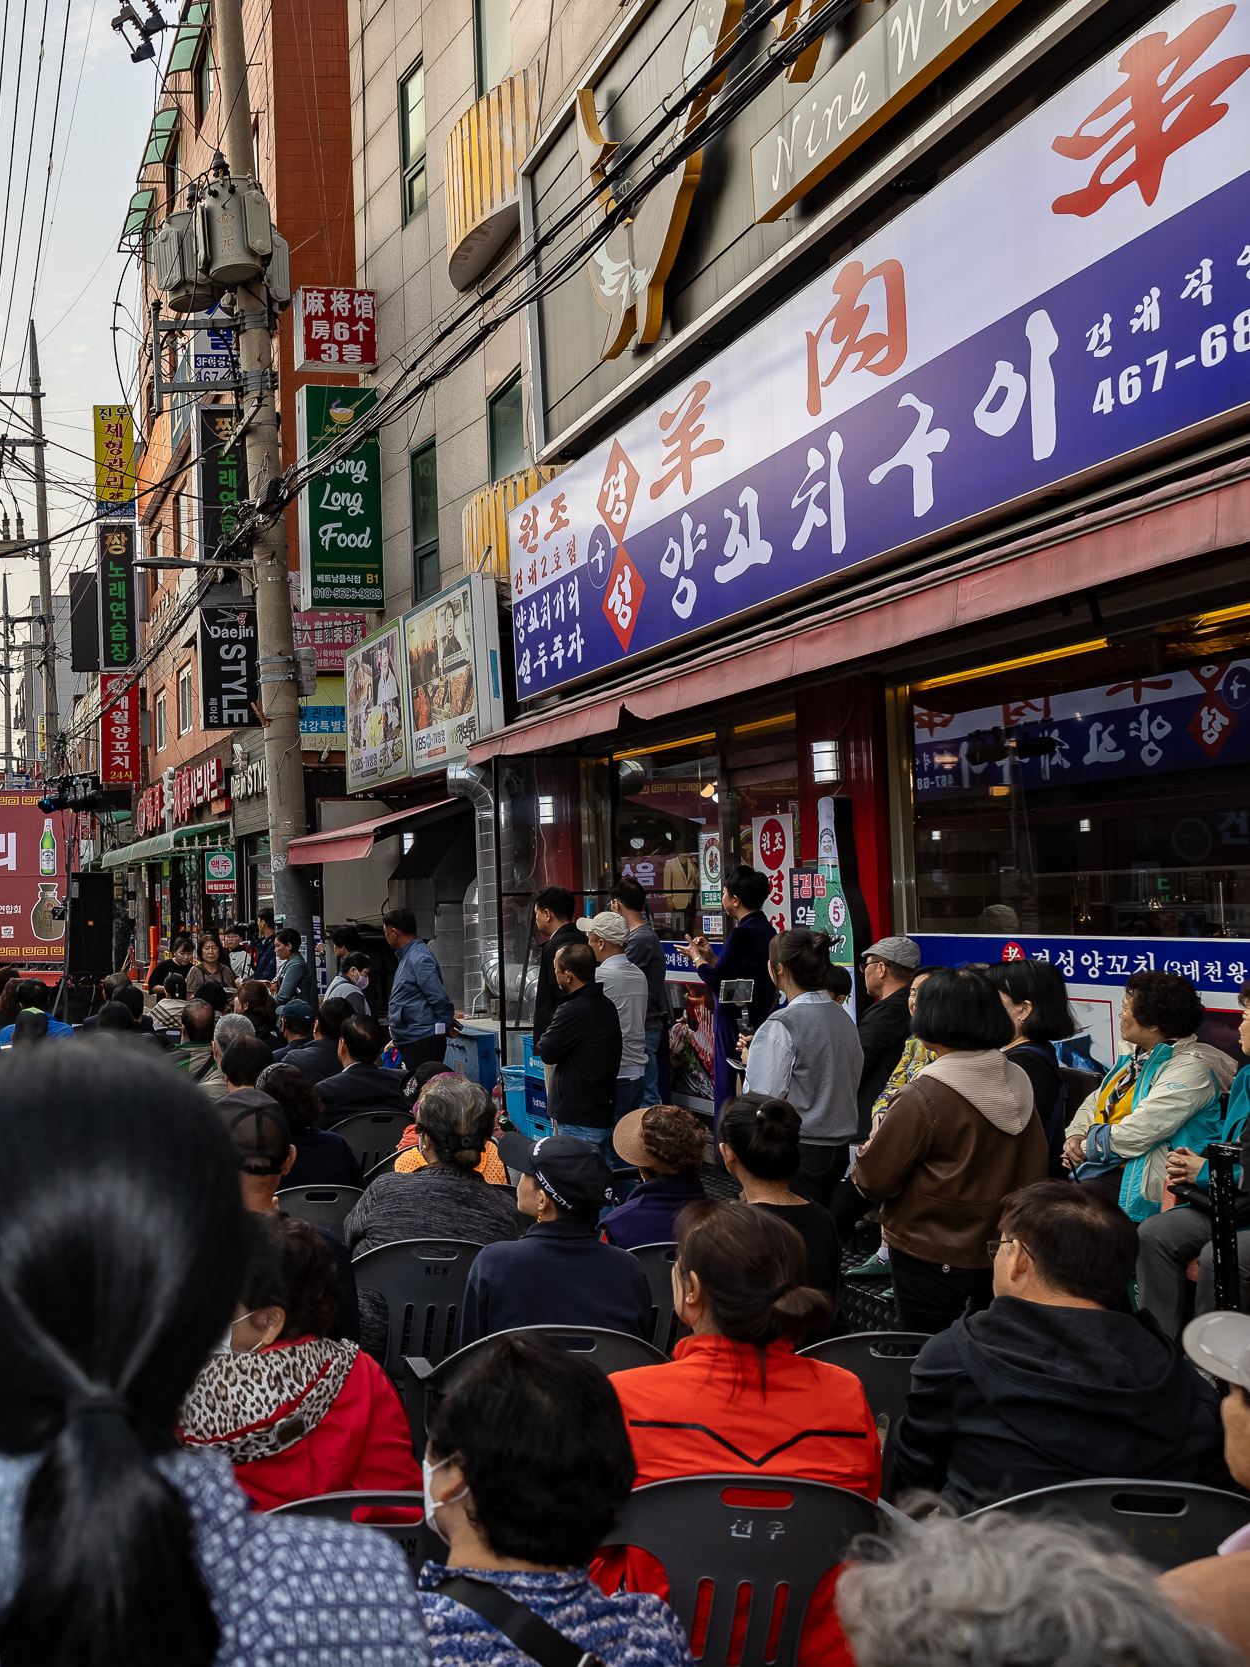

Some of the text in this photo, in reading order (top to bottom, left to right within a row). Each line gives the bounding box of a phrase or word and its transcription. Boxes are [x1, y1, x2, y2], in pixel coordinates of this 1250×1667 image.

[772, 70, 870, 192] Nine
[306, 290, 375, 318] 麻将馆
[311, 320, 371, 342] 房6个
[98, 407, 131, 422] 진우
[102, 424, 127, 491] 체형관리
[659, 308, 1060, 620] 양꼬치구이
[109, 492, 124, 500] 2F
[319, 490, 363, 516] Long
[104, 533, 128, 556] 짱
[318, 522, 372, 551] Food
[316, 572, 380, 585] 베트남음식점 B1
[312, 586, 383, 601] 010-5696-9889
[107, 561, 130, 662] 노래연습장
[219, 644, 249, 724] STYLE
[110, 770, 134, 781] 24시
[761, 830, 785, 855] 원조
[210, 859, 231, 870] 맥주
[799, 873, 827, 898] 경성
